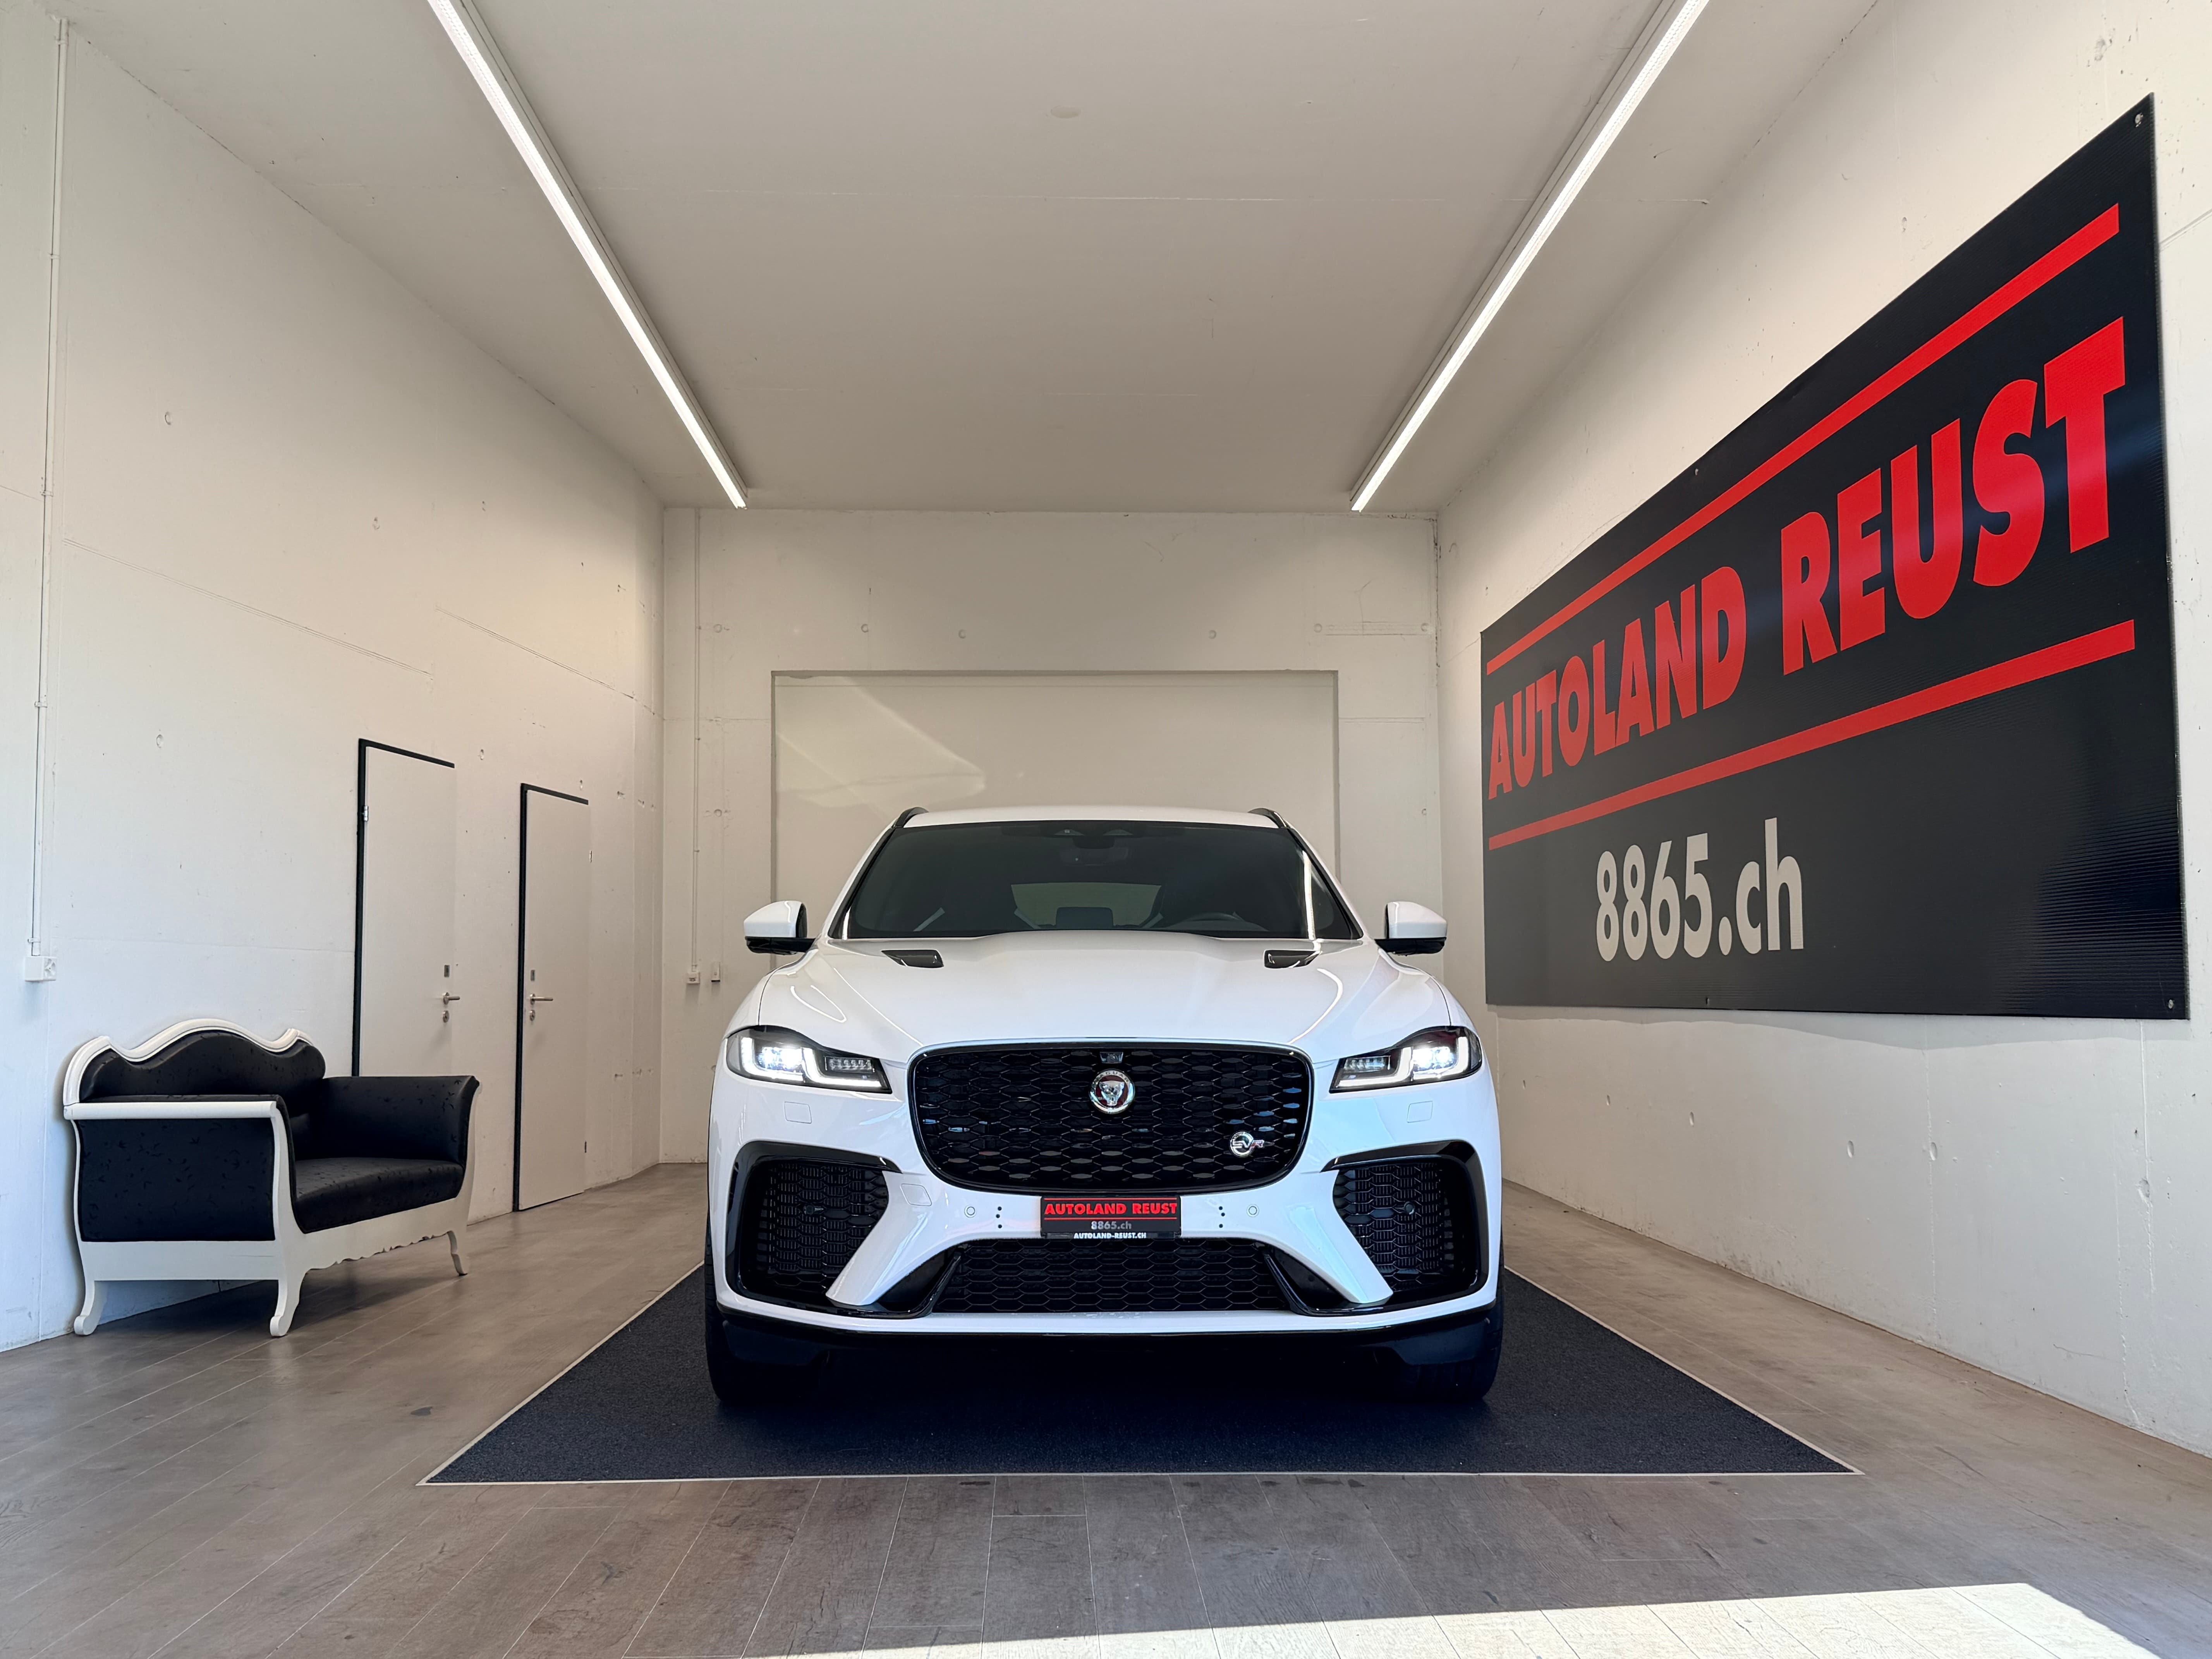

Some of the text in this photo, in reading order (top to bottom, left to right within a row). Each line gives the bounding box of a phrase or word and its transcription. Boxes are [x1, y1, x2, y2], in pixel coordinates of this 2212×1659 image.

[1489, 316, 2126, 800] AUTOLAND REUST
[1596, 817, 1804, 962] 8865.ch
[1044, 1202, 1178, 1215] AUTOLAND REUST
[1091, 1220, 1132, 1230] 8865.ch
